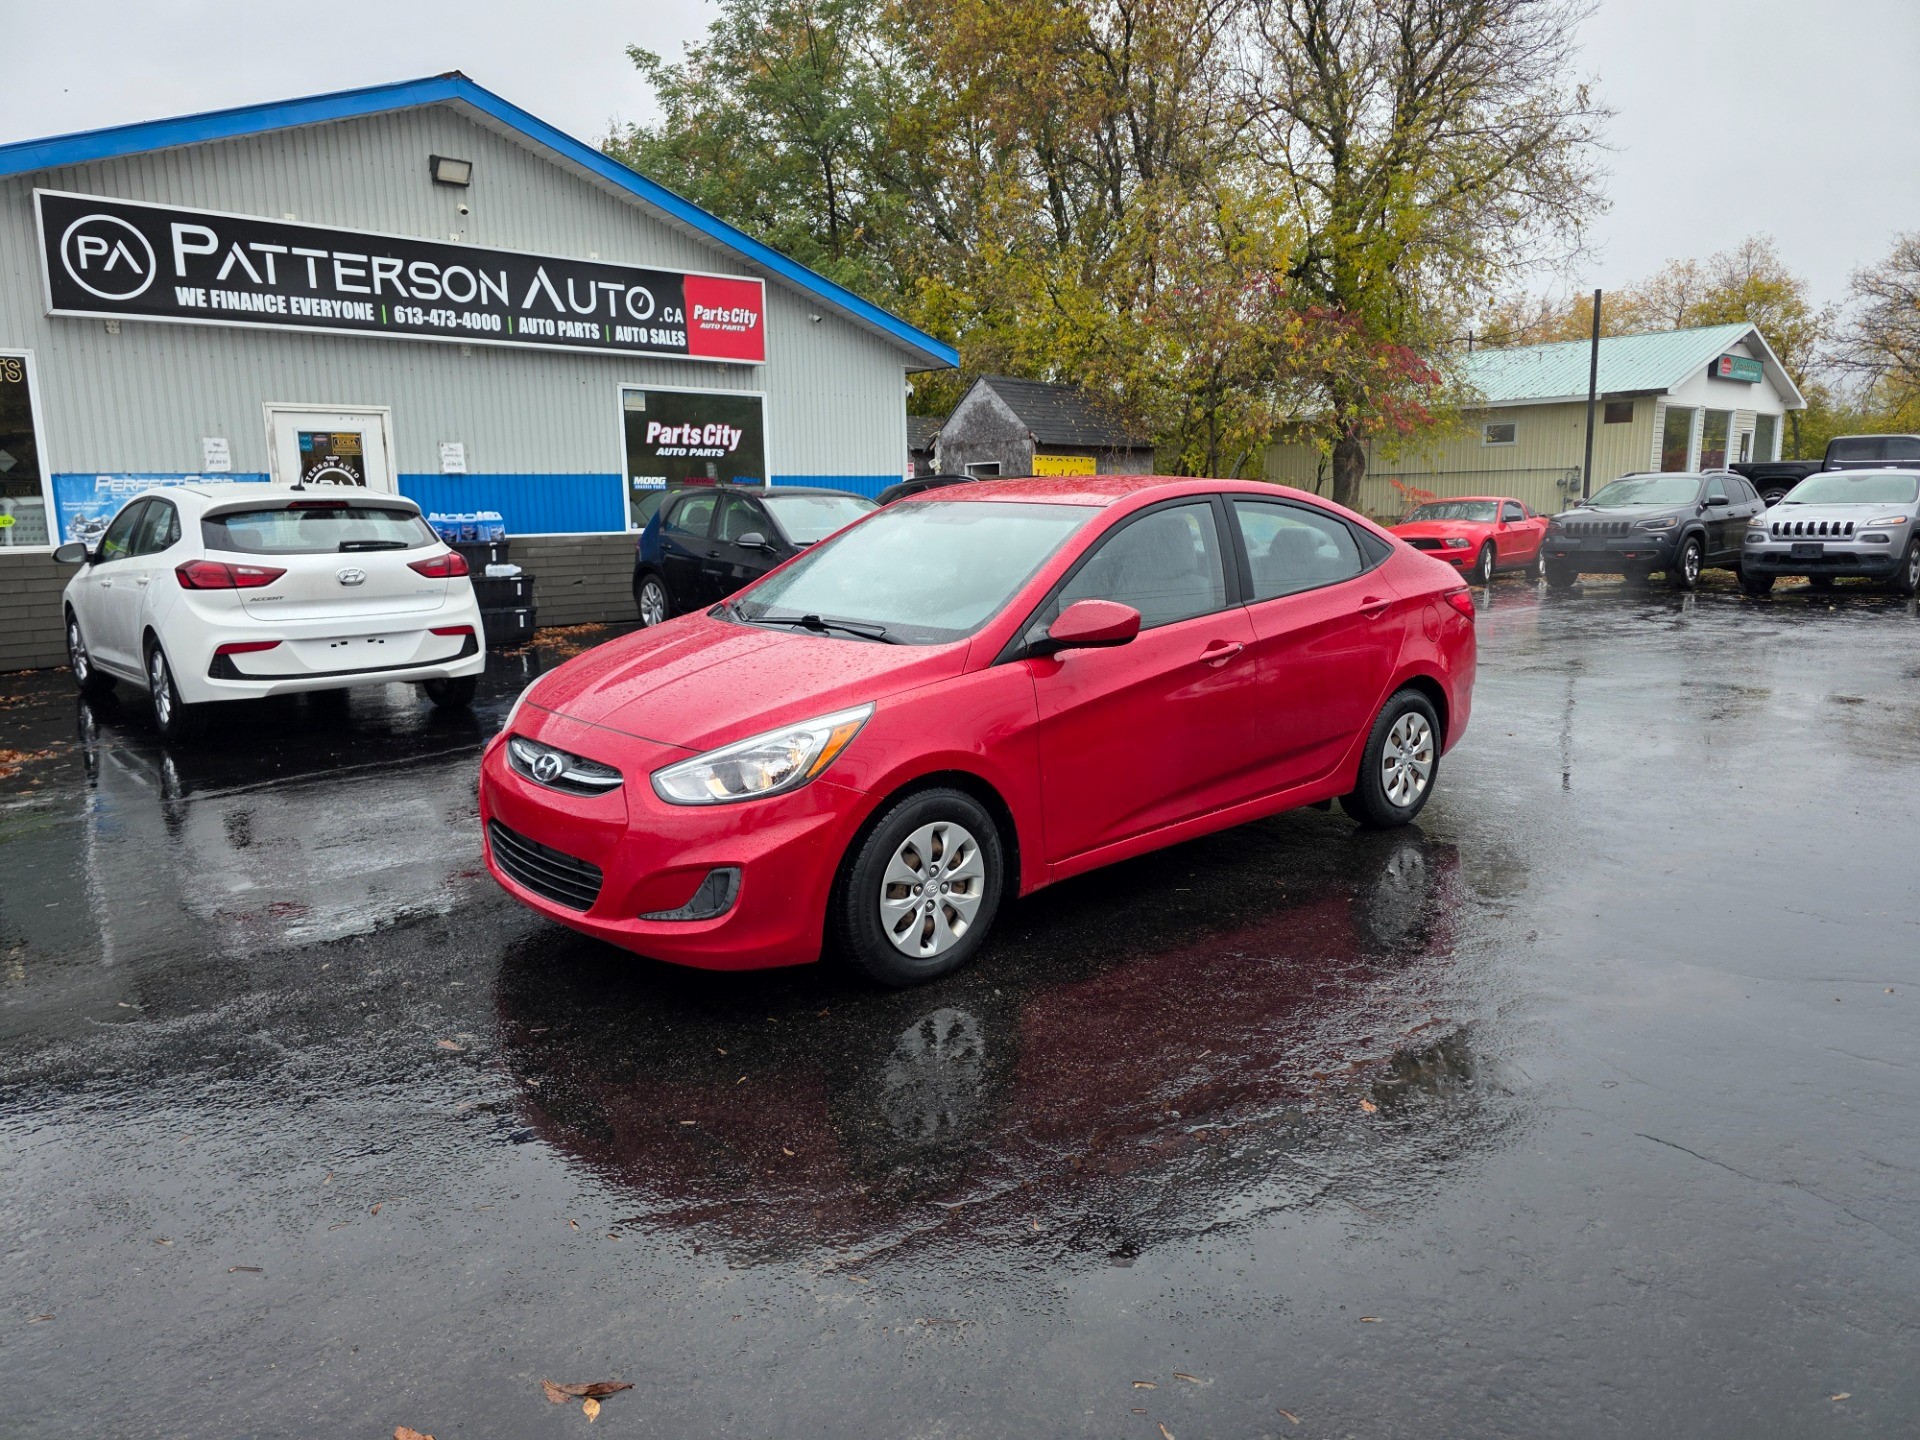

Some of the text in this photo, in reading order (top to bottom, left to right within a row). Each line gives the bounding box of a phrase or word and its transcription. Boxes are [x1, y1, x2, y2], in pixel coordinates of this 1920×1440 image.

[170, 222, 510, 307] PATTERSON
[175, 286, 375, 322] WE FINANCE EVERYONE
[394, 305, 501, 332] 613-473-4000
[518, 317, 600, 340] AUTO PARTS
[700, 322, 746, 332] AUTO PARTS
[615, 325, 686, 347] AUTO SALES
[656, 447, 725, 457] AUTO PARTS
[338, 462, 360, 479] AUTO
[633, 476, 667, 485] MOOG
